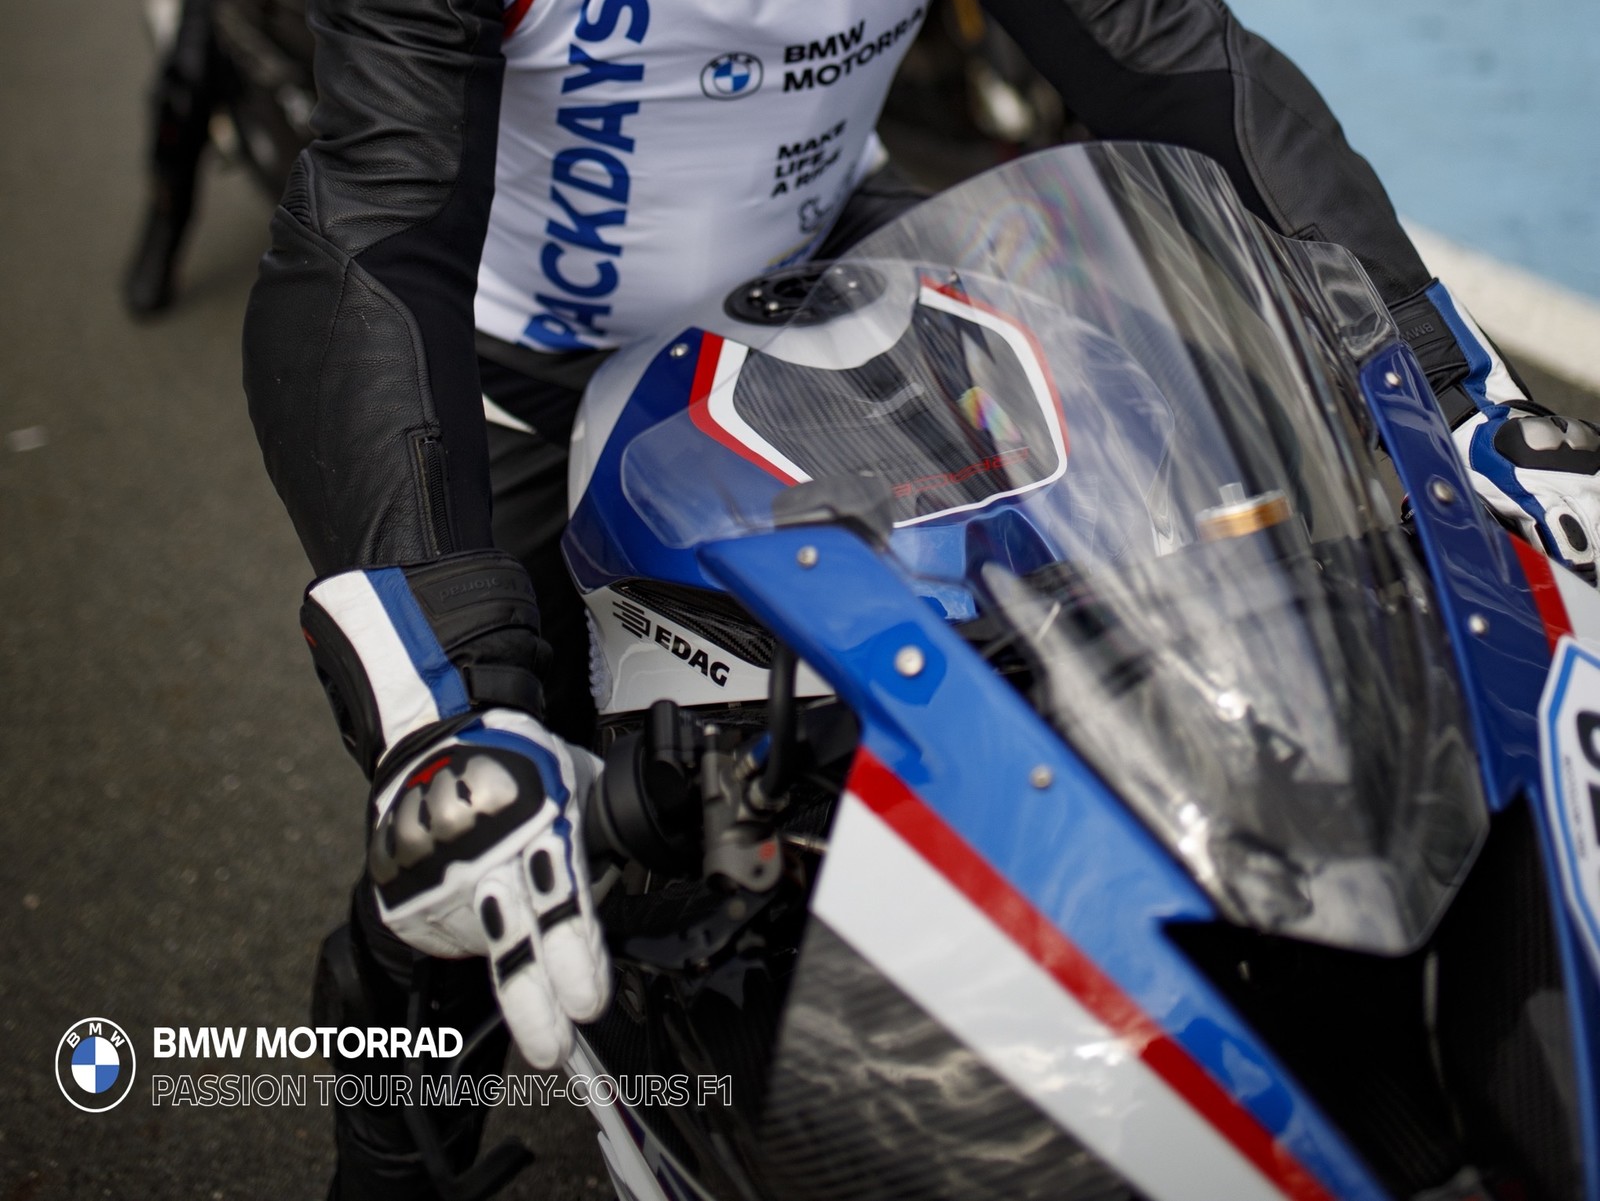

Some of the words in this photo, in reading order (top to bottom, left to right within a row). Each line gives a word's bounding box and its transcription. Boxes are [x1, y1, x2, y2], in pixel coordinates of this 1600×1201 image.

[783, 7, 923, 93] MOTORRA
[784, 18, 866, 65] BMW
[654, 624, 731, 687] EDAG
